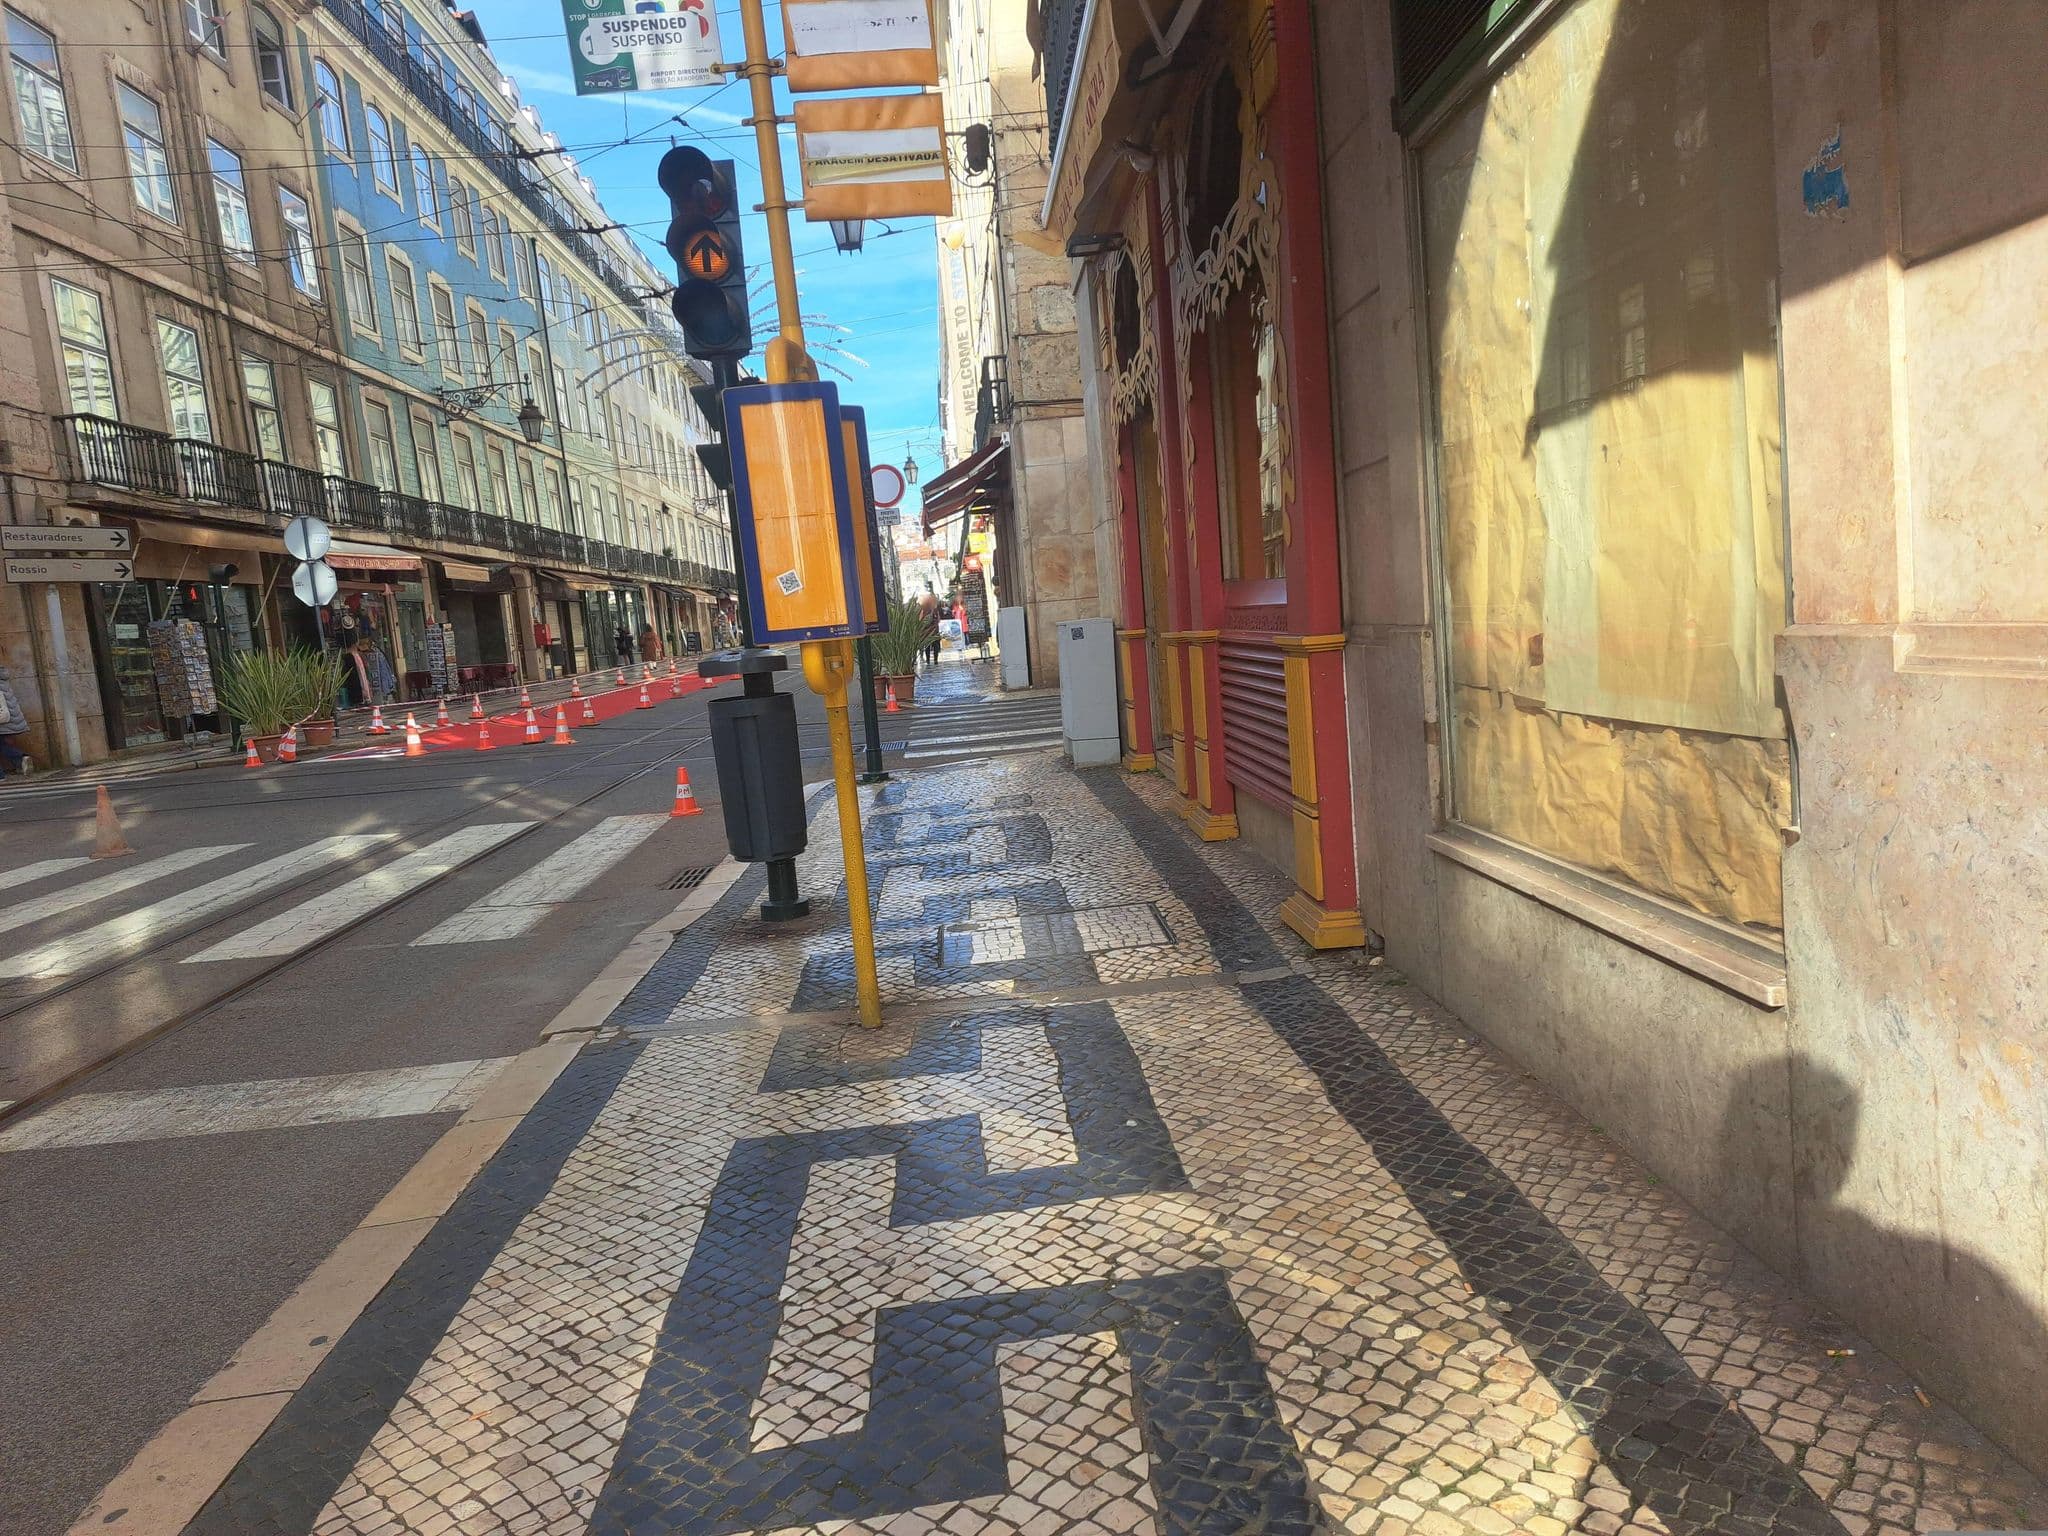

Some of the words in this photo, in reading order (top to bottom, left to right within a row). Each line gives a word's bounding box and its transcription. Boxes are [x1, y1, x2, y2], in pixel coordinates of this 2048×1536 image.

[602, 16, 687, 34] SUSPENDED
[611, 32, 682, 48] SUSPENSO
[650, 69, 676, 77] AIRPORT
[678, 67, 709, 75] DIRECTION
[954, 305, 968, 328] TO
[956, 327, 978, 417] WELCOME
[4, 531, 83, 543] Restauradores
[10, 565, 48, 574] Rossio
